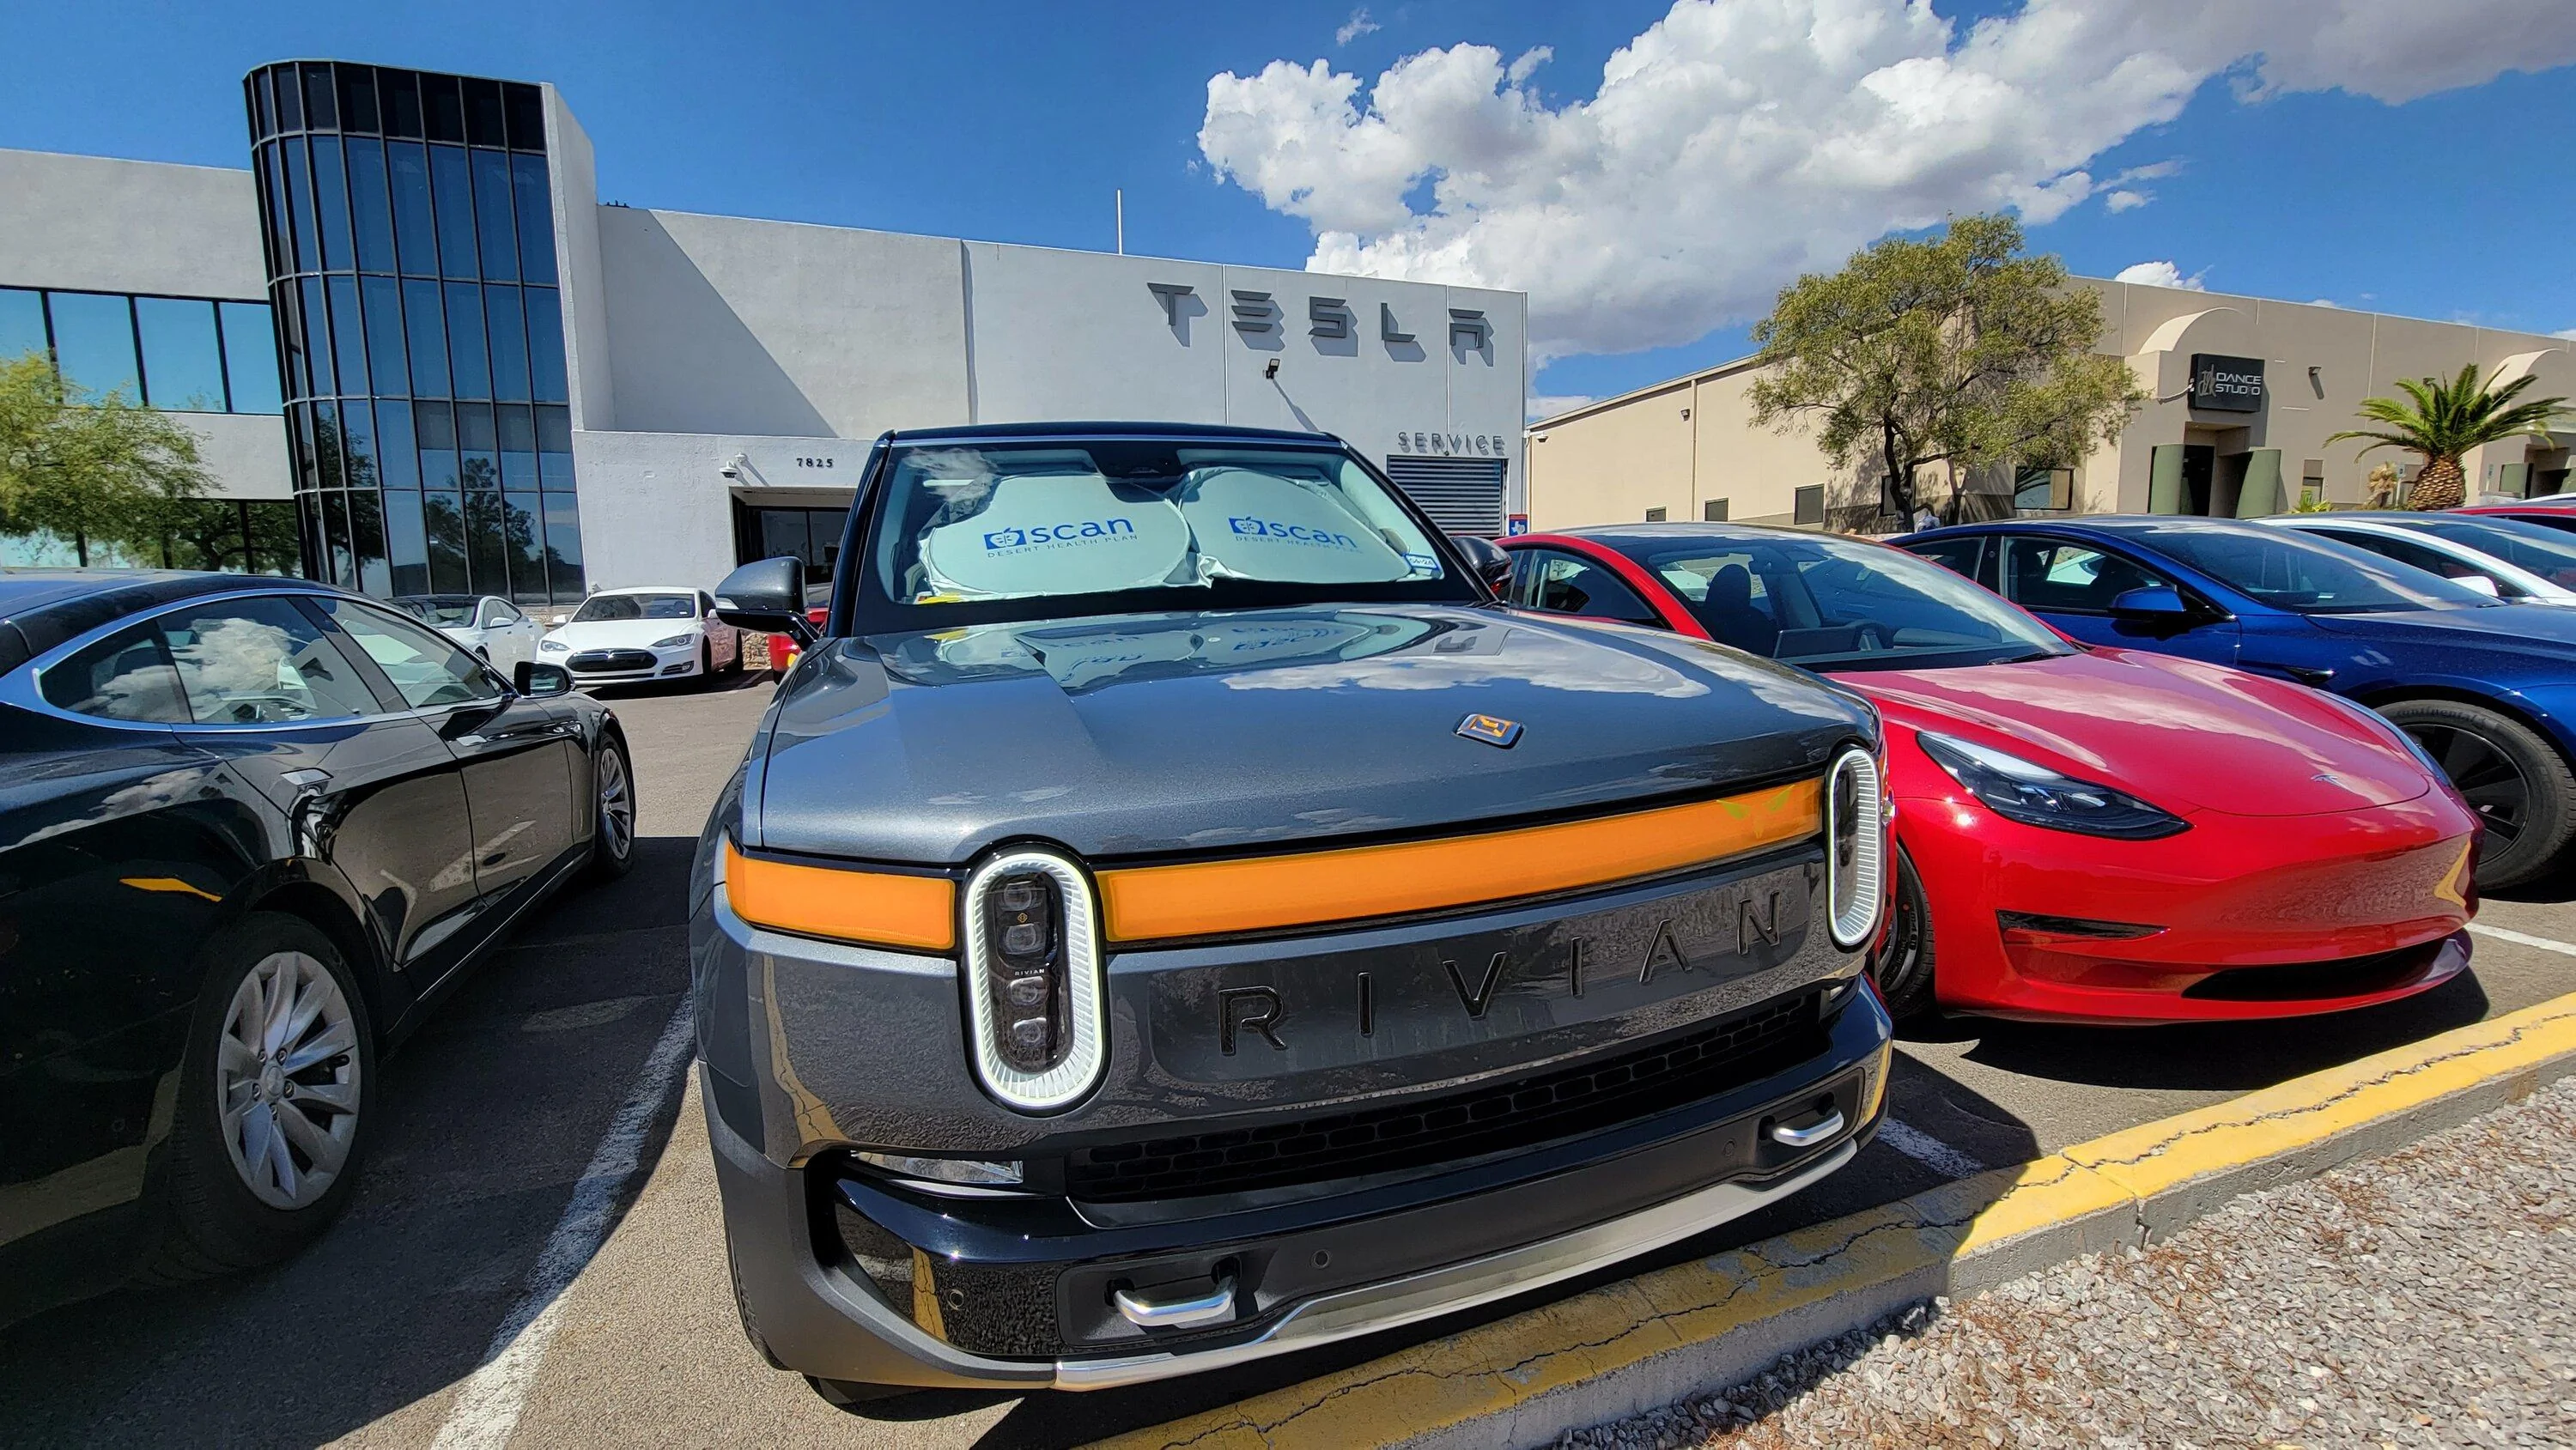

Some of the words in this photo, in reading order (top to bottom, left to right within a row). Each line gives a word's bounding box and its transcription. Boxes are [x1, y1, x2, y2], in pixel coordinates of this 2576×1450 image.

[1147, 282, 1485, 348] TESLA
[2215, 383, 2261, 396] STUDO
[2216, 372, 2262, 385] DANCE
[1398, 432, 1502, 450] SERVICE
[797, 458, 834, 468] 7825
[1030, 519, 1134, 543] scan
[1270, 523, 1357, 549] scan
[987, 545, 1038, 558] DESERT
[1047, 539, 1097, 550] HEALTH
[1104, 534, 1138, 543] PLAN
[1218, 890, 1782, 1057] RIVIAN
